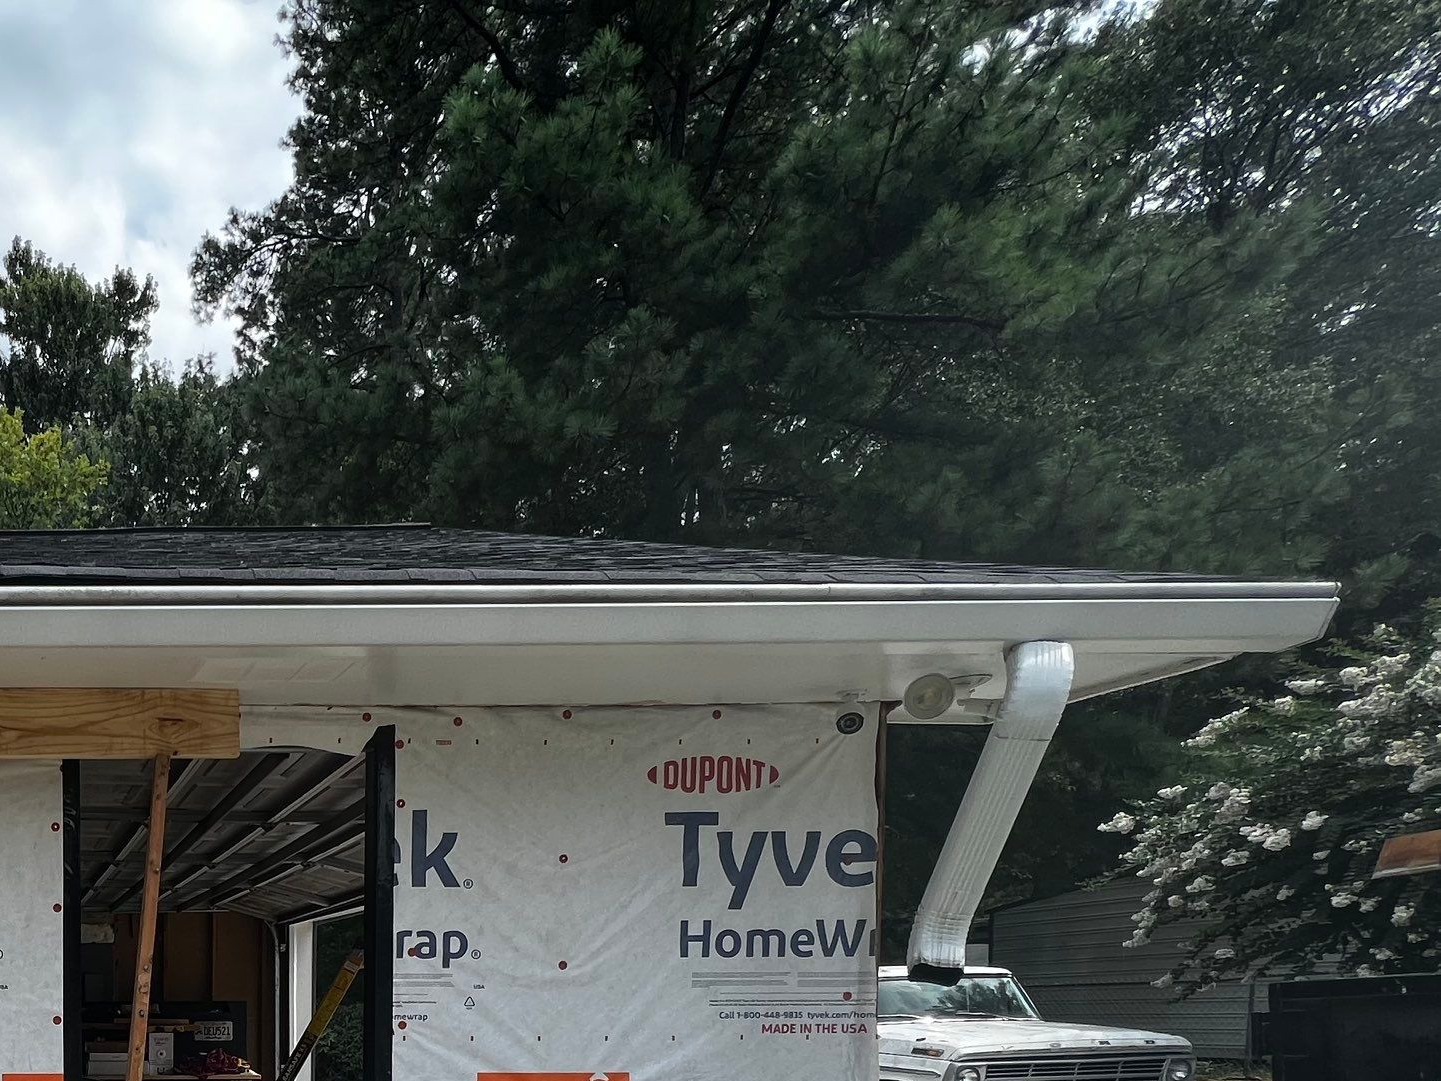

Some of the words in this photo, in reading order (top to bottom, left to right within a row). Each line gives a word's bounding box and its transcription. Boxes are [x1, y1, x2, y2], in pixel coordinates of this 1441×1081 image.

[663, 756, 765, 794] DUPONT
[719, 1011, 735, 1019] Call
[761, 1024, 796, 1034] MADE
[800, 1024, 812, 1034] IN
[815, 1024, 837, 1034] THE
[841, 1024, 867, 1034] USA
